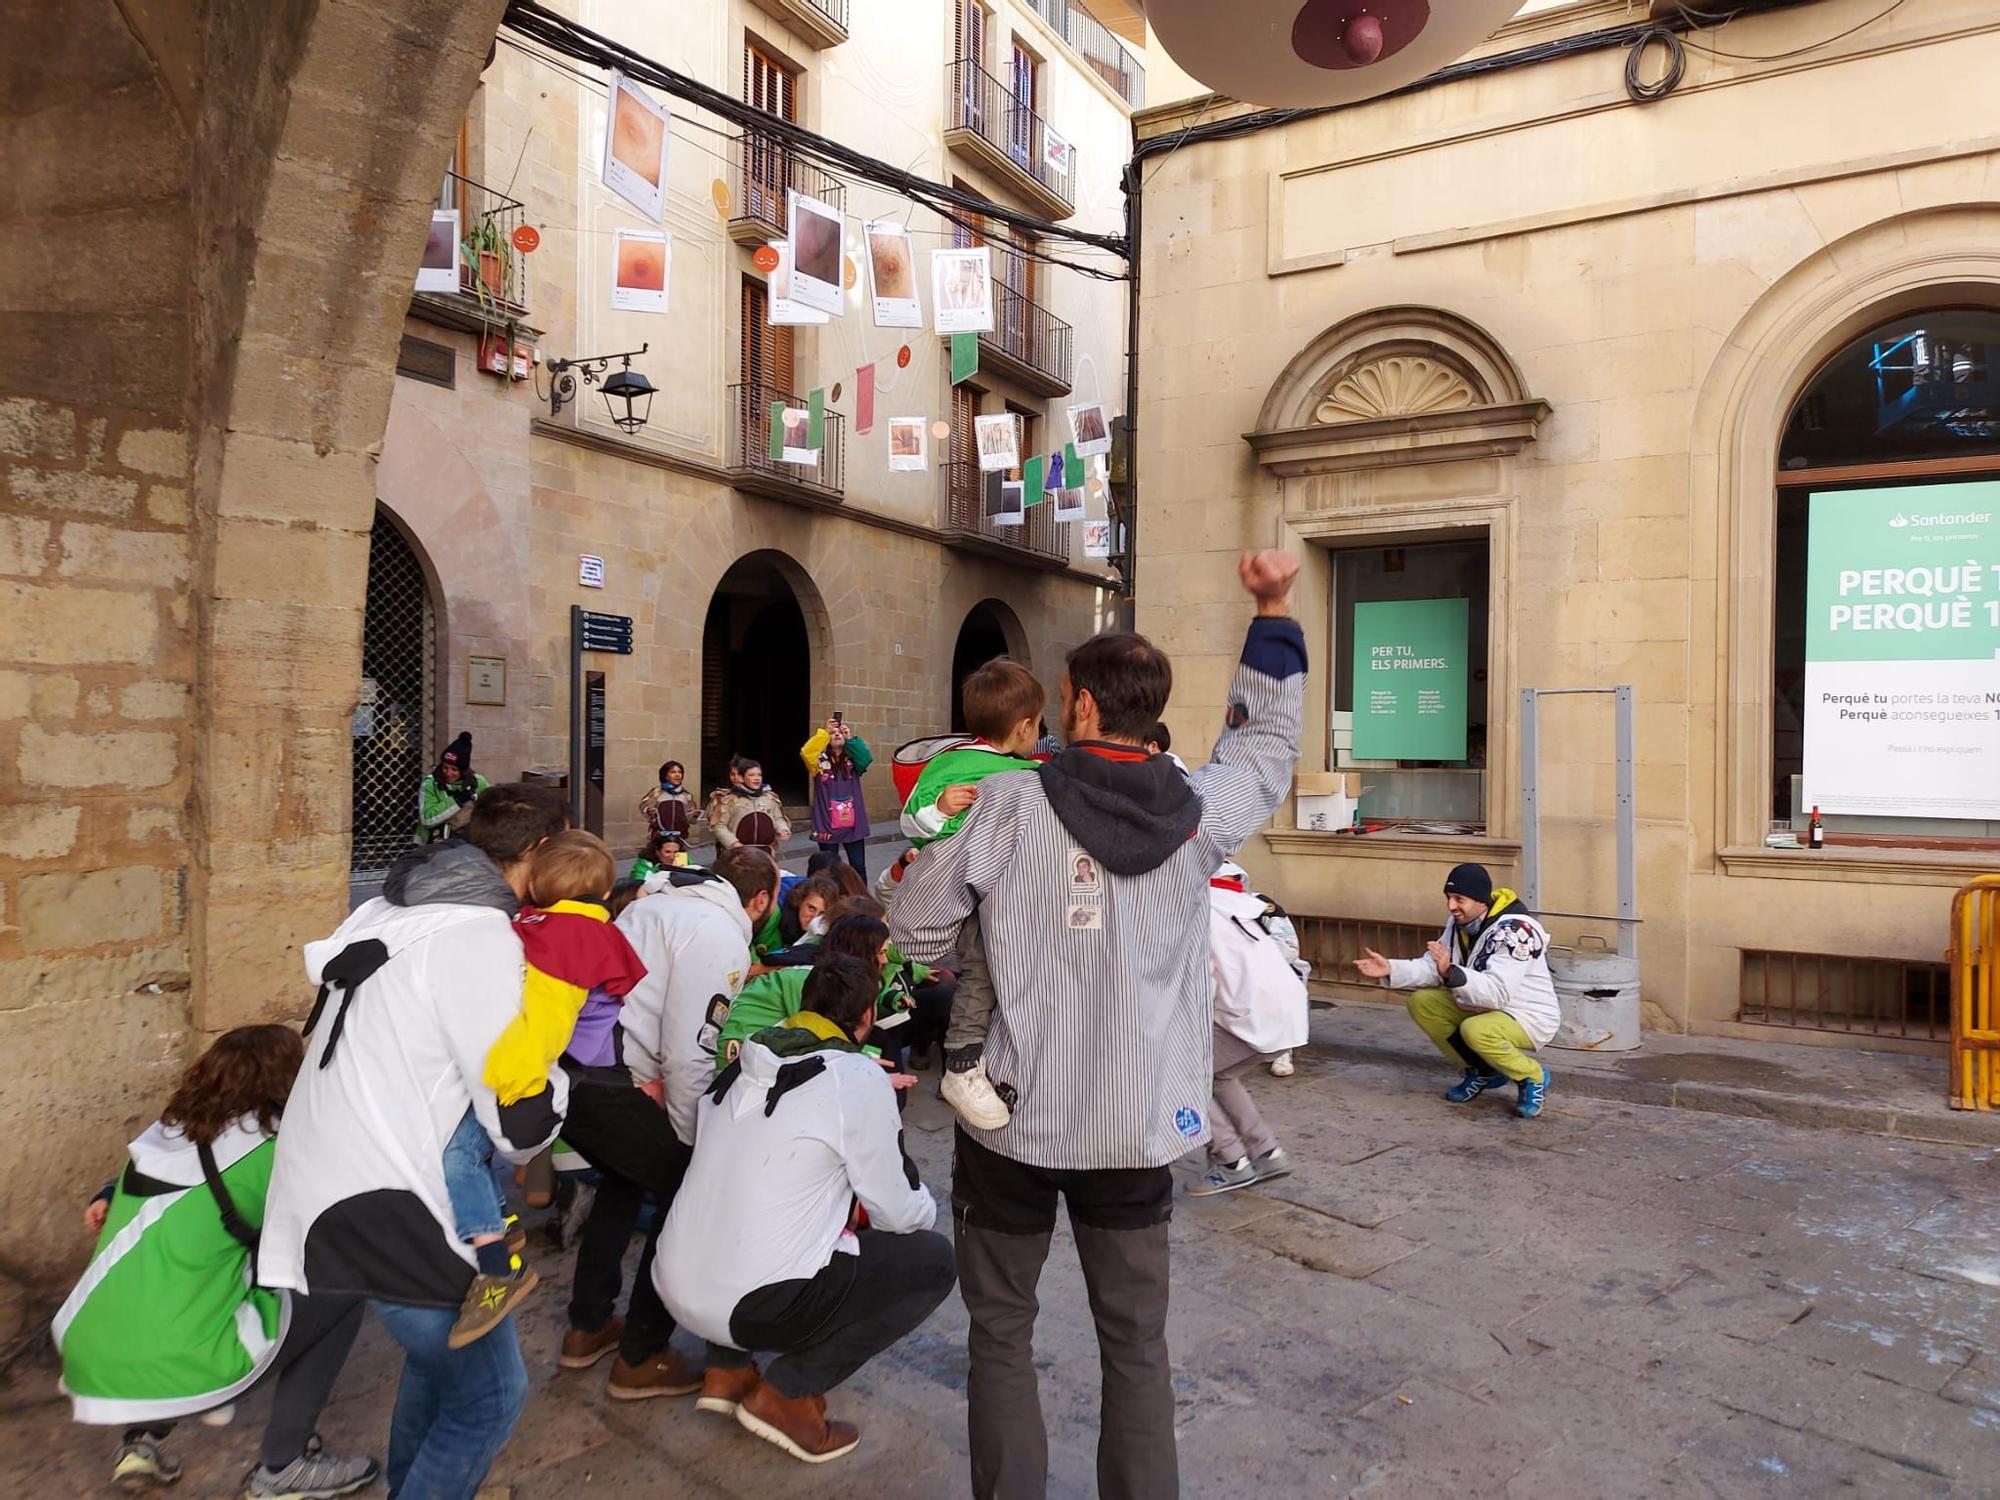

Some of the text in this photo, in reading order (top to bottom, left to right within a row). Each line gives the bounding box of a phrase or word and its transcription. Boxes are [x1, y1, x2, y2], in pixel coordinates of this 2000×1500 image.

[1910, 511, 1992, 527] Santander
[1839, 559, 1982, 598] PERQUÈ
[1829, 595, 1973, 632] PERQUÈ
[1371, 646, 1415, 657] PER TU,
[1371, 658, 1449, 670] ELS PRIMERS.
[1874, 693, 1888, 704] tu
[1891, 694, 1934, 707] portes
